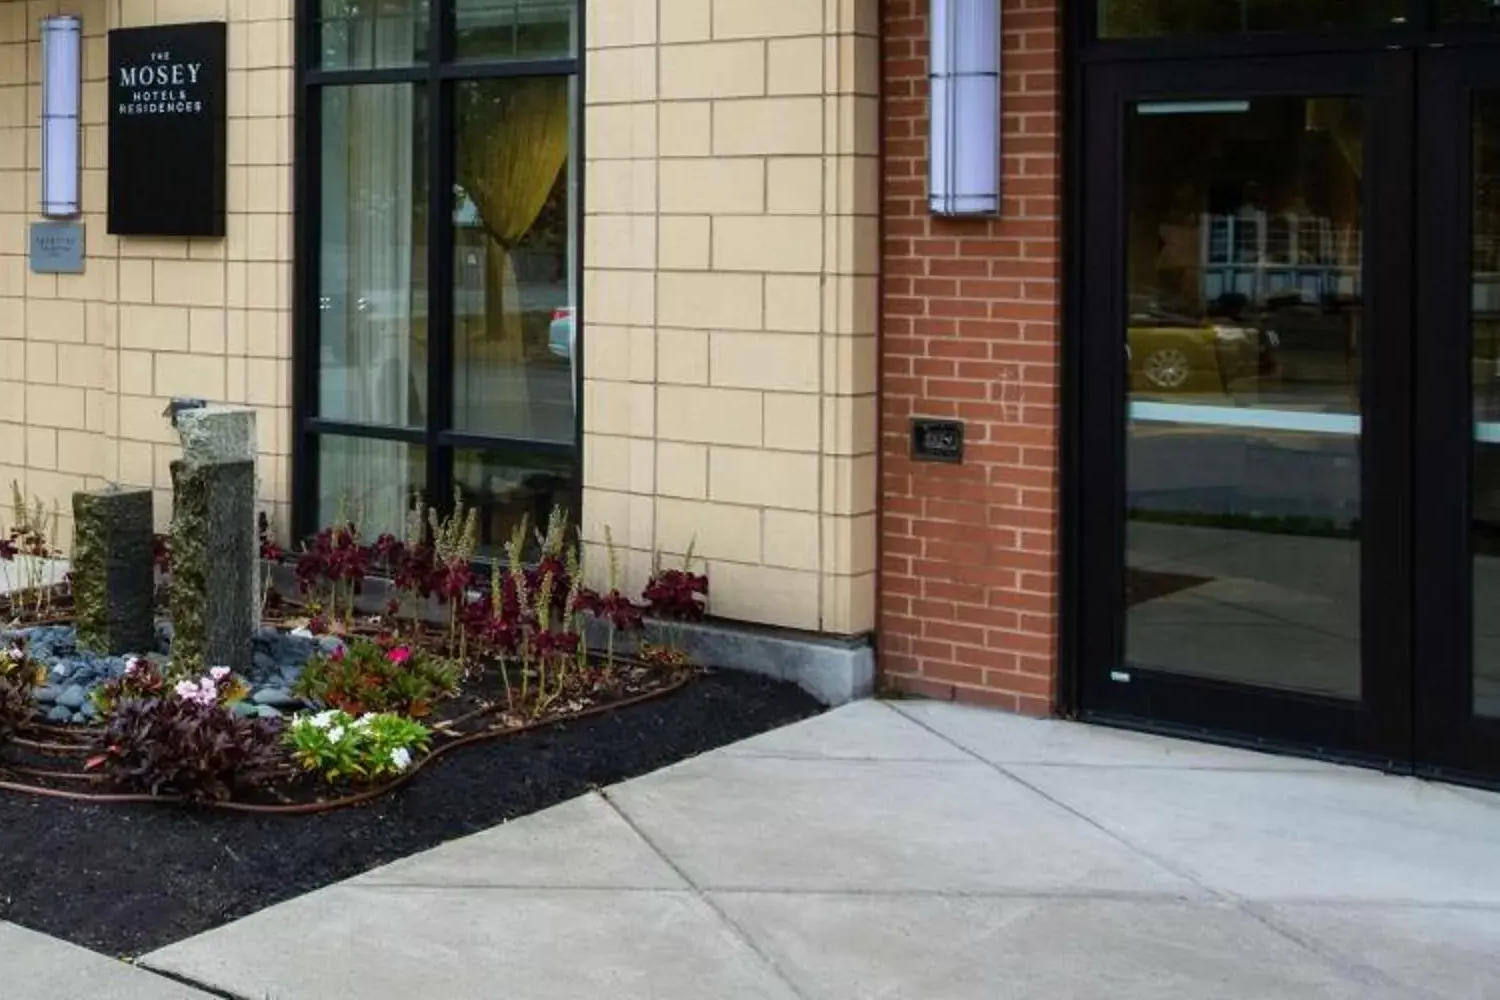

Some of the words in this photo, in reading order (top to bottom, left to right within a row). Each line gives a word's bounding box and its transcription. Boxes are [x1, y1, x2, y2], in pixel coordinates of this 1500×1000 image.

[150, 51, 170, 61] THE
[119, 63, 203, 88] MOSEY
[118, 101, 203, 115] RESIDENCES
